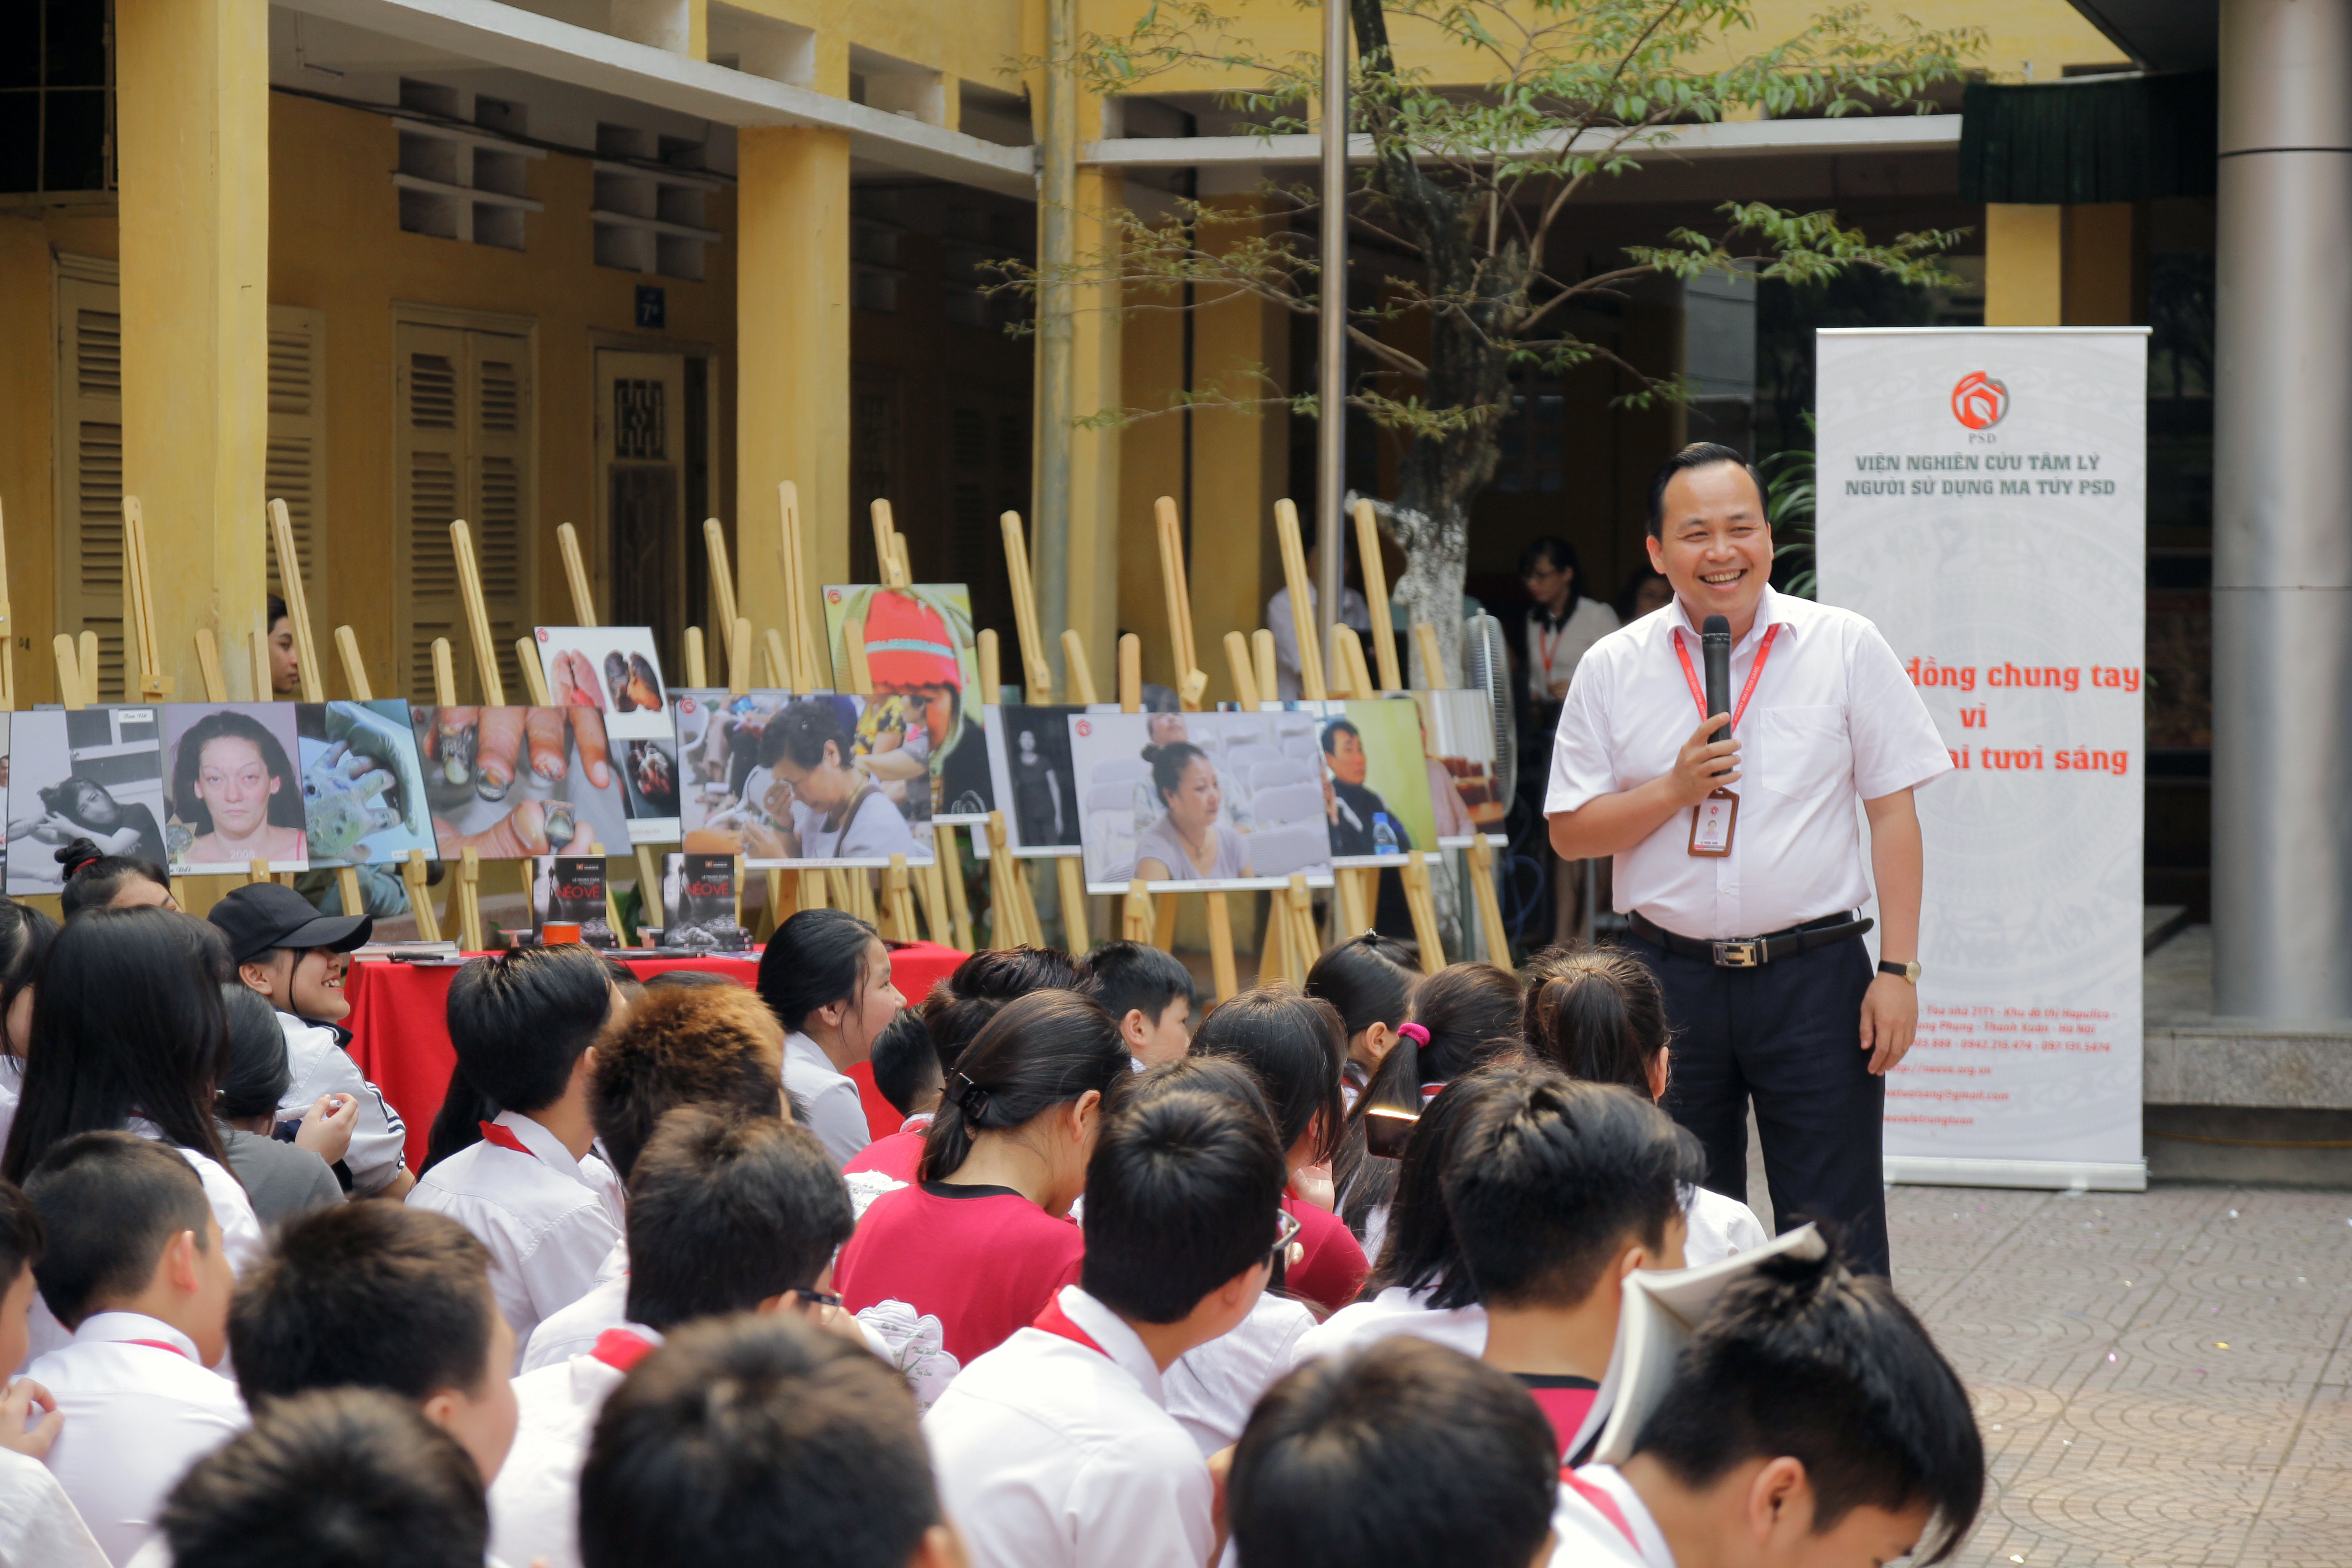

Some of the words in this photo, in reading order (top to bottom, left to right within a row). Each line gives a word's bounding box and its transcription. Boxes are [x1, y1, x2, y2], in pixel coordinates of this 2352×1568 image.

[1969, 433, 1996, 444] PSD
[1856, 452, 1900, 473] VIỆN
[1907, 452, 1979, 471] NGHIÊN
[1985, 452, 2022, 470] CỨU
[2029, 453, 2071, 470] TÂM
[2078, 452, 2100, 470] LÝ
[1846, 475, 1905, 496] NGƯỜI
[1911, 475, 1936, 495] SỬ
[1942, 480, 1994, 498] DỤNG
[2000, 480, 2031, 495] MA
[2079, 480, 2116, 495] PSD
[1906, 657, 1977, 692] đồng
[1988, 663, 2080, 692] chung
[2092, 665, 2140, 692] tay
[1960, 702, 1988, 729] vì
[1949, 744, 1970, 770] ai
[1981, 745, 2044, 770] tươi
[2055, 745, 2129, 775] sáng
